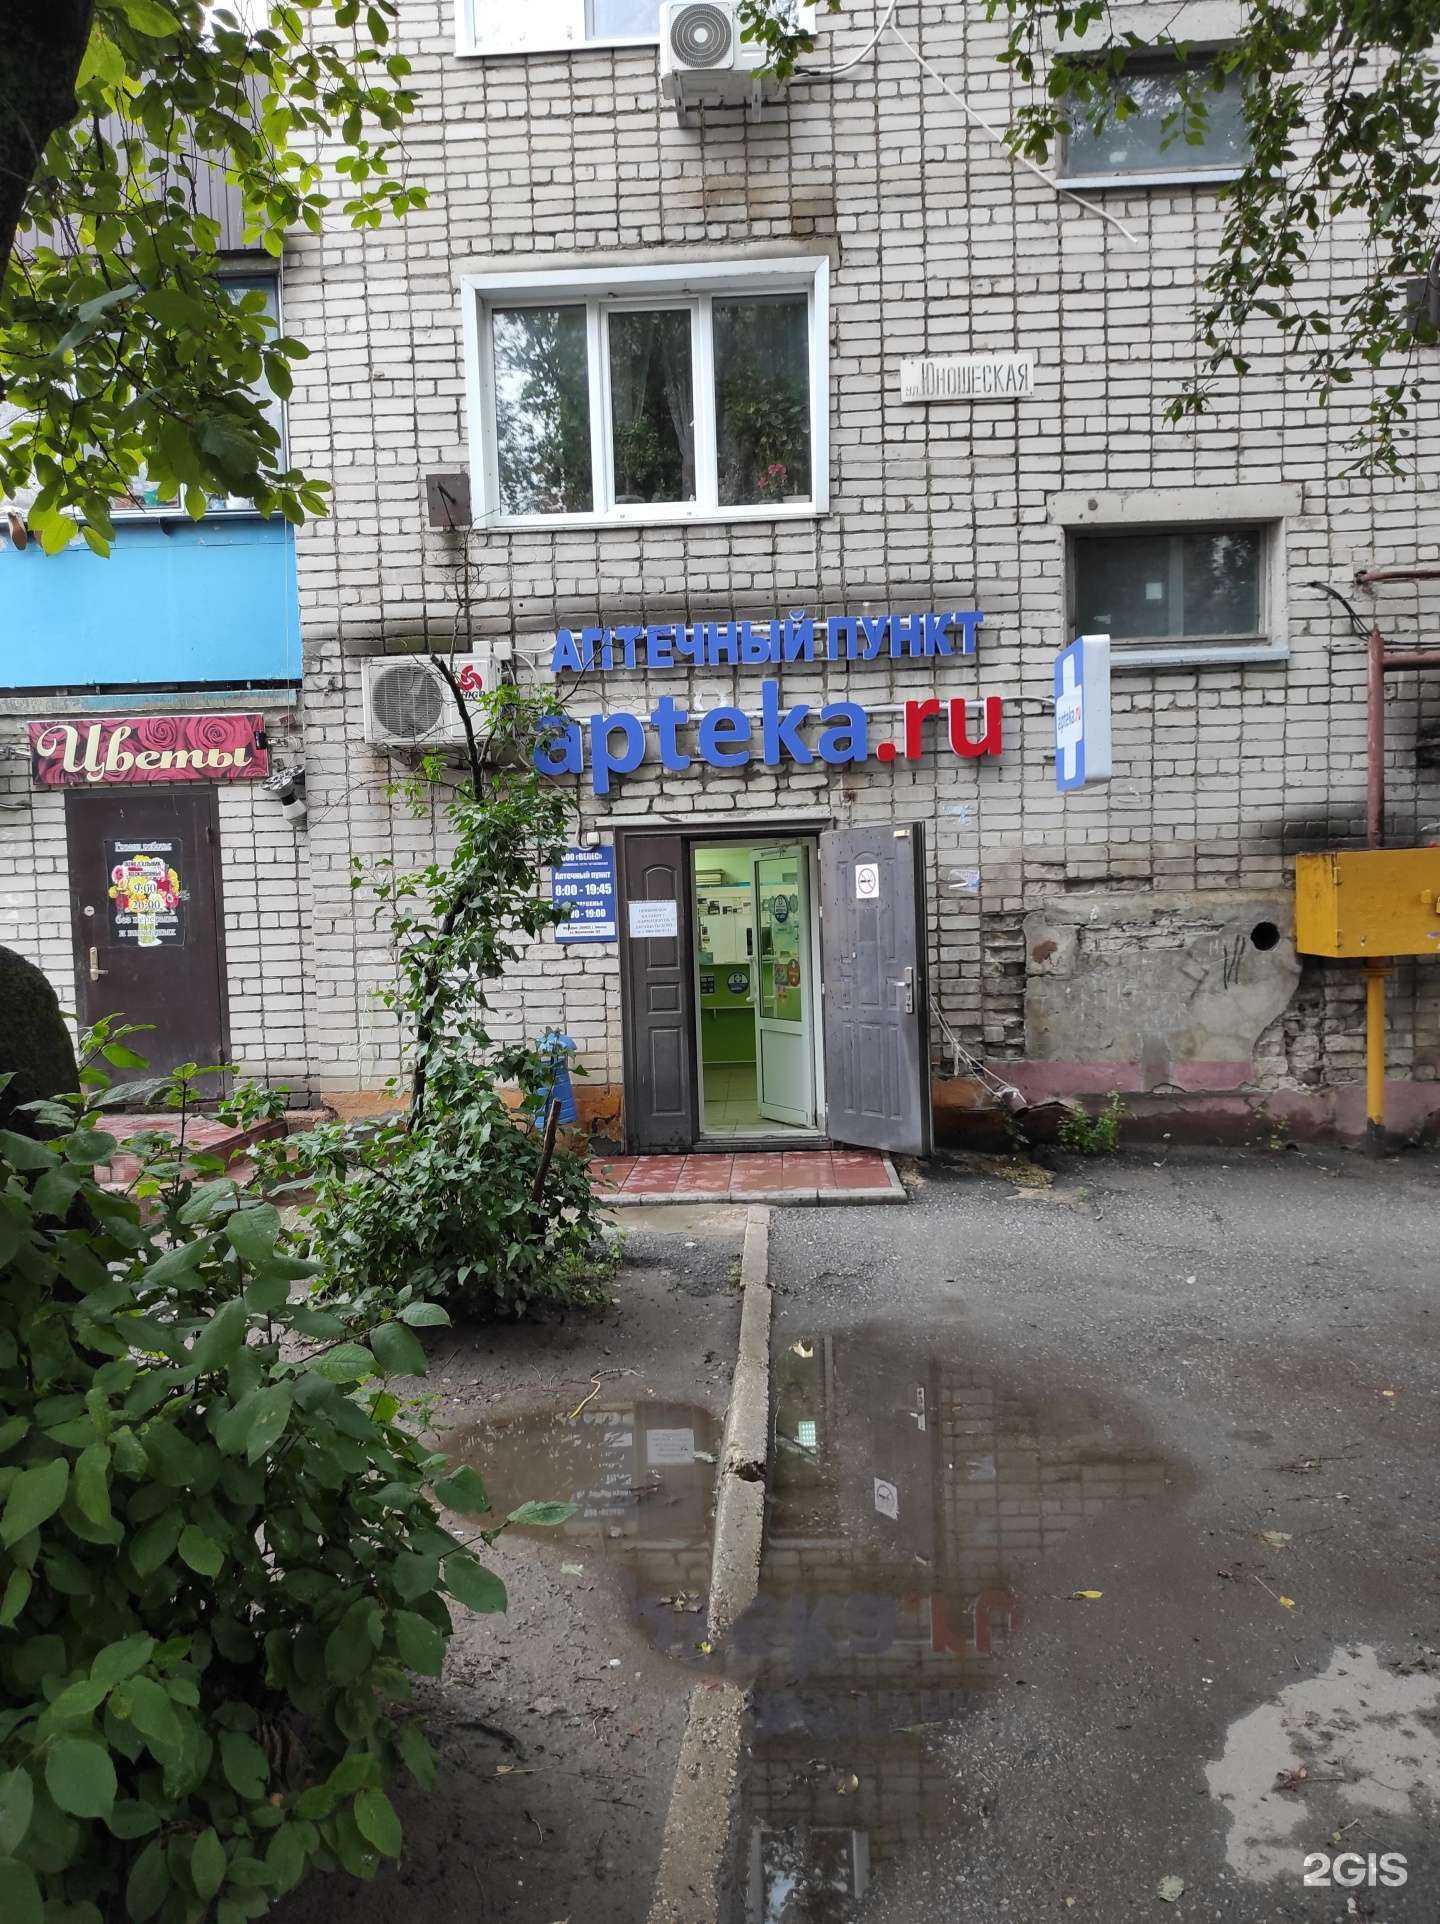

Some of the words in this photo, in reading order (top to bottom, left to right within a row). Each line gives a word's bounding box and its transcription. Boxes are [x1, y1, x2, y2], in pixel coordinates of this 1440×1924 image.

[550, 610, 815, 673] АПТЕЧНЫЙ
[827, 611, 984, 661] ПУНКТ
[37, 724, 253, 782] Цветы
[532, 680, 1004, 795] apteka.ru
[132, 901, 161, 910] 20:00
[133, 884, 156, 893] 9:00
[555, 884, 578, 896] 8:00
[585, 883, 612, 895] 19:45
